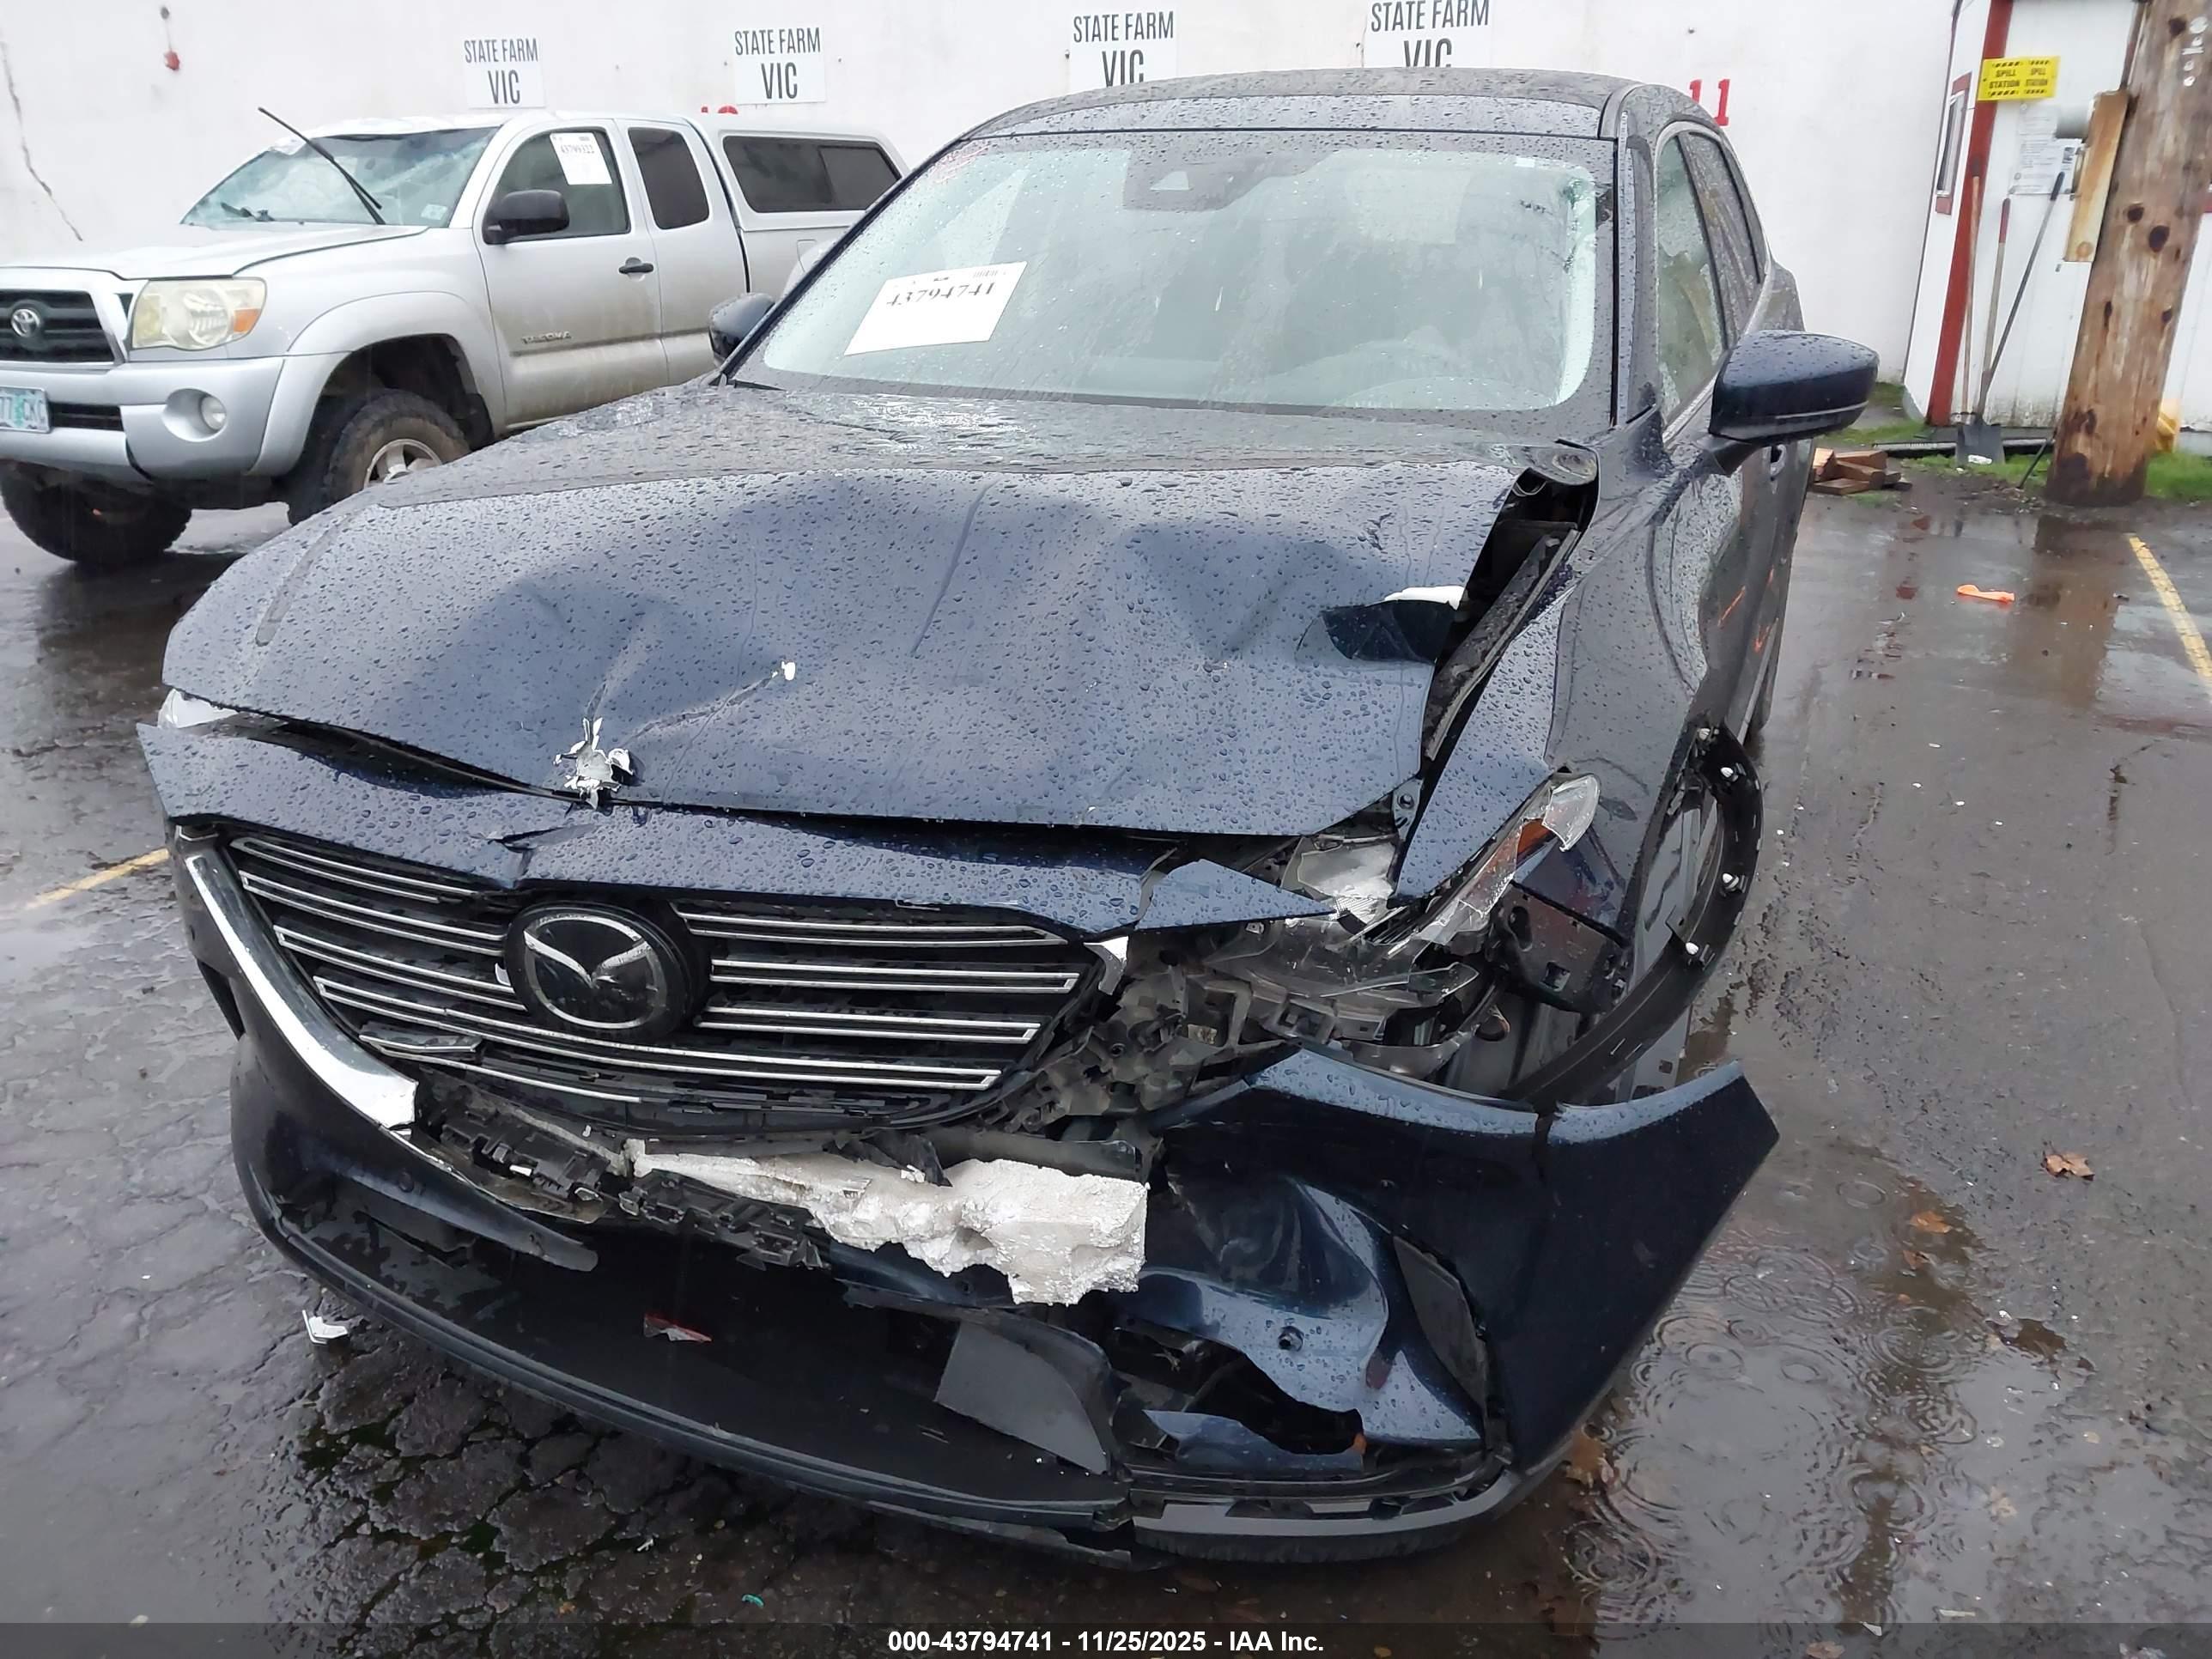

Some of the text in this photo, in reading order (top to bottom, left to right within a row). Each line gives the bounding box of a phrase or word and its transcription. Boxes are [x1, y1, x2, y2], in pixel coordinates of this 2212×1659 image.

[1073, 10, 1174, 43] STATE FARM
[1371, 0, 1489, 33] STATE FARM
[464, 38, 538, 64] STATE FARM
[734, 27, 821, 56] STATE FARM
[1404, 38, 1452, 68] VIC
[761, 62, 798, 100] VIC
[1102, 49, 1144, 88] VIC
[1995, 69, 2016, 77] SPILL
[488, 70, 520, 105] VIC
[1989, 80, 2021, 88] STATION
[886, 282, 995, 307] 43794741
